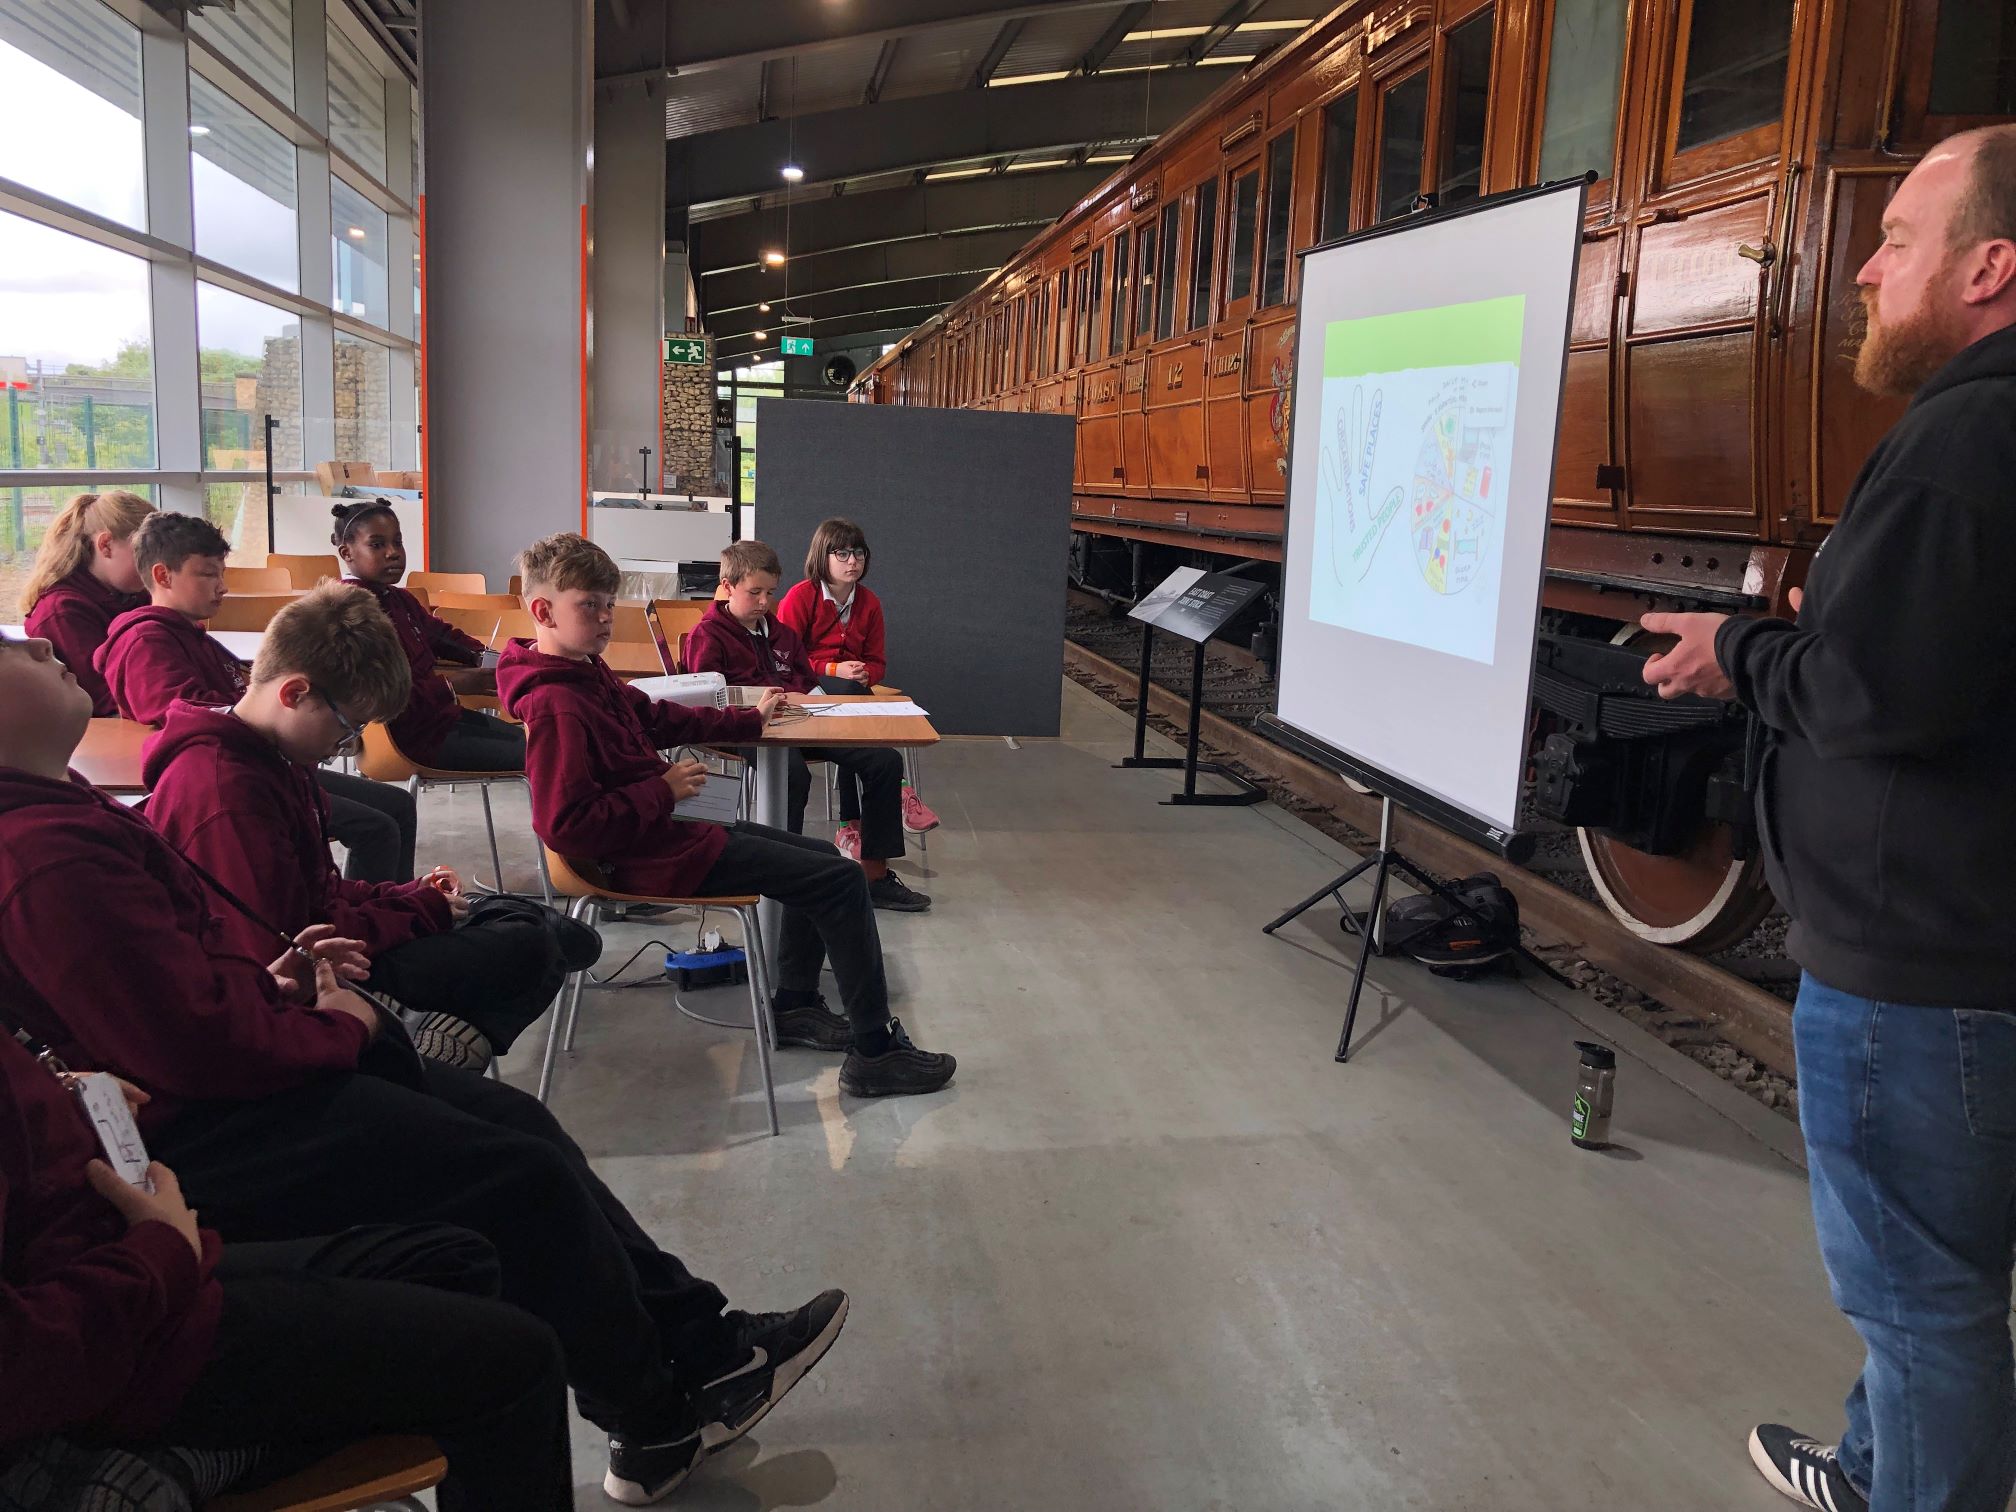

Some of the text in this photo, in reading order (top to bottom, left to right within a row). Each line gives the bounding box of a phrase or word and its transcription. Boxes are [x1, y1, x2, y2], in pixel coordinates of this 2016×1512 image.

[1167, 361, 1184, 390] 12
[1358, 400, 1383, 497] SAFE PLACES
[1352, 494, 1402, 563] TRUSTED PEOPLE
[1187, 599, 1206, 610] STOCK
[1188, 587, 1204, 597] EAST
[1197, 589, 1216, 600] COAST
